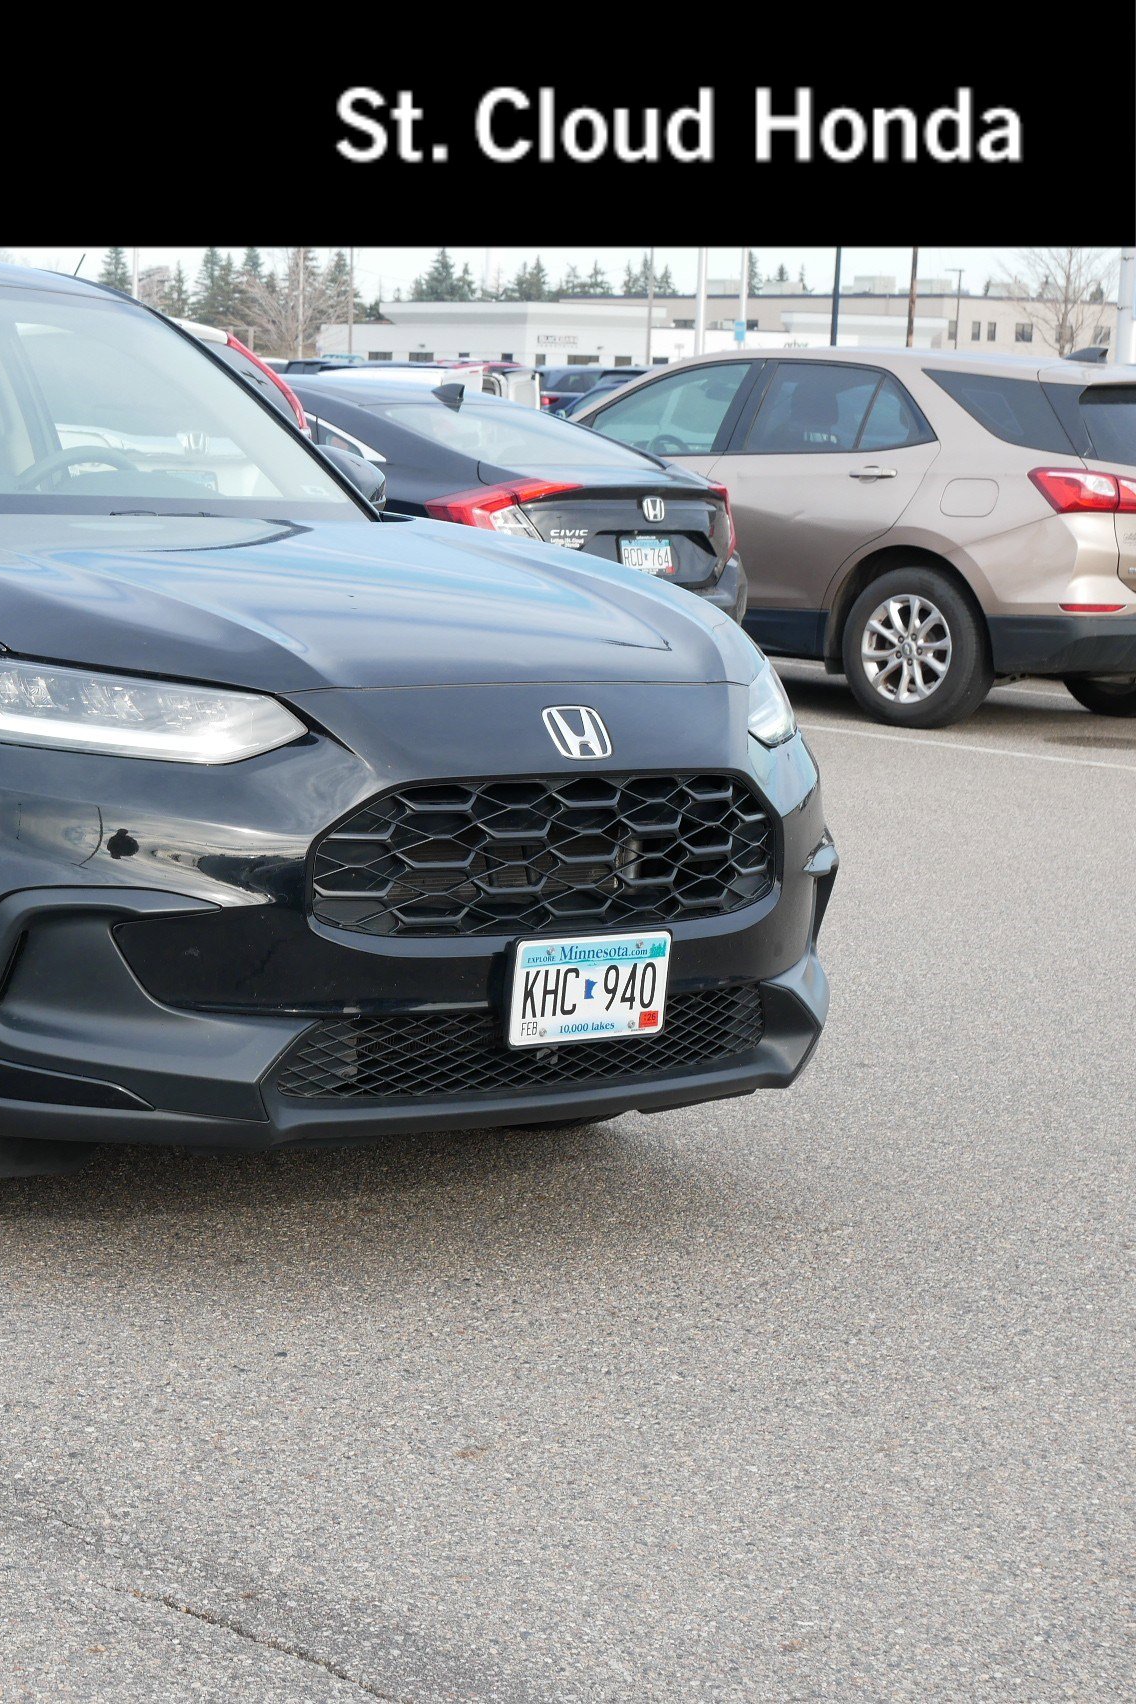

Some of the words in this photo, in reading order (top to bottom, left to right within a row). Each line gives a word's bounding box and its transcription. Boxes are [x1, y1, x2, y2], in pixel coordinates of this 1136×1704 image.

[649, 547, 670, 567] 764
[527, 955, 556, 964] EXPLORE
[559, 945, 648, 962] Minnesota.com
[522, 968, 579, 1019] KHC
[604, 962, 656, 1011] 940
[520, 1020, 538, 1037] FEB
[558, 1022, 589, 1035] 10,000
[591, 1020, 615, 1032] lakes
